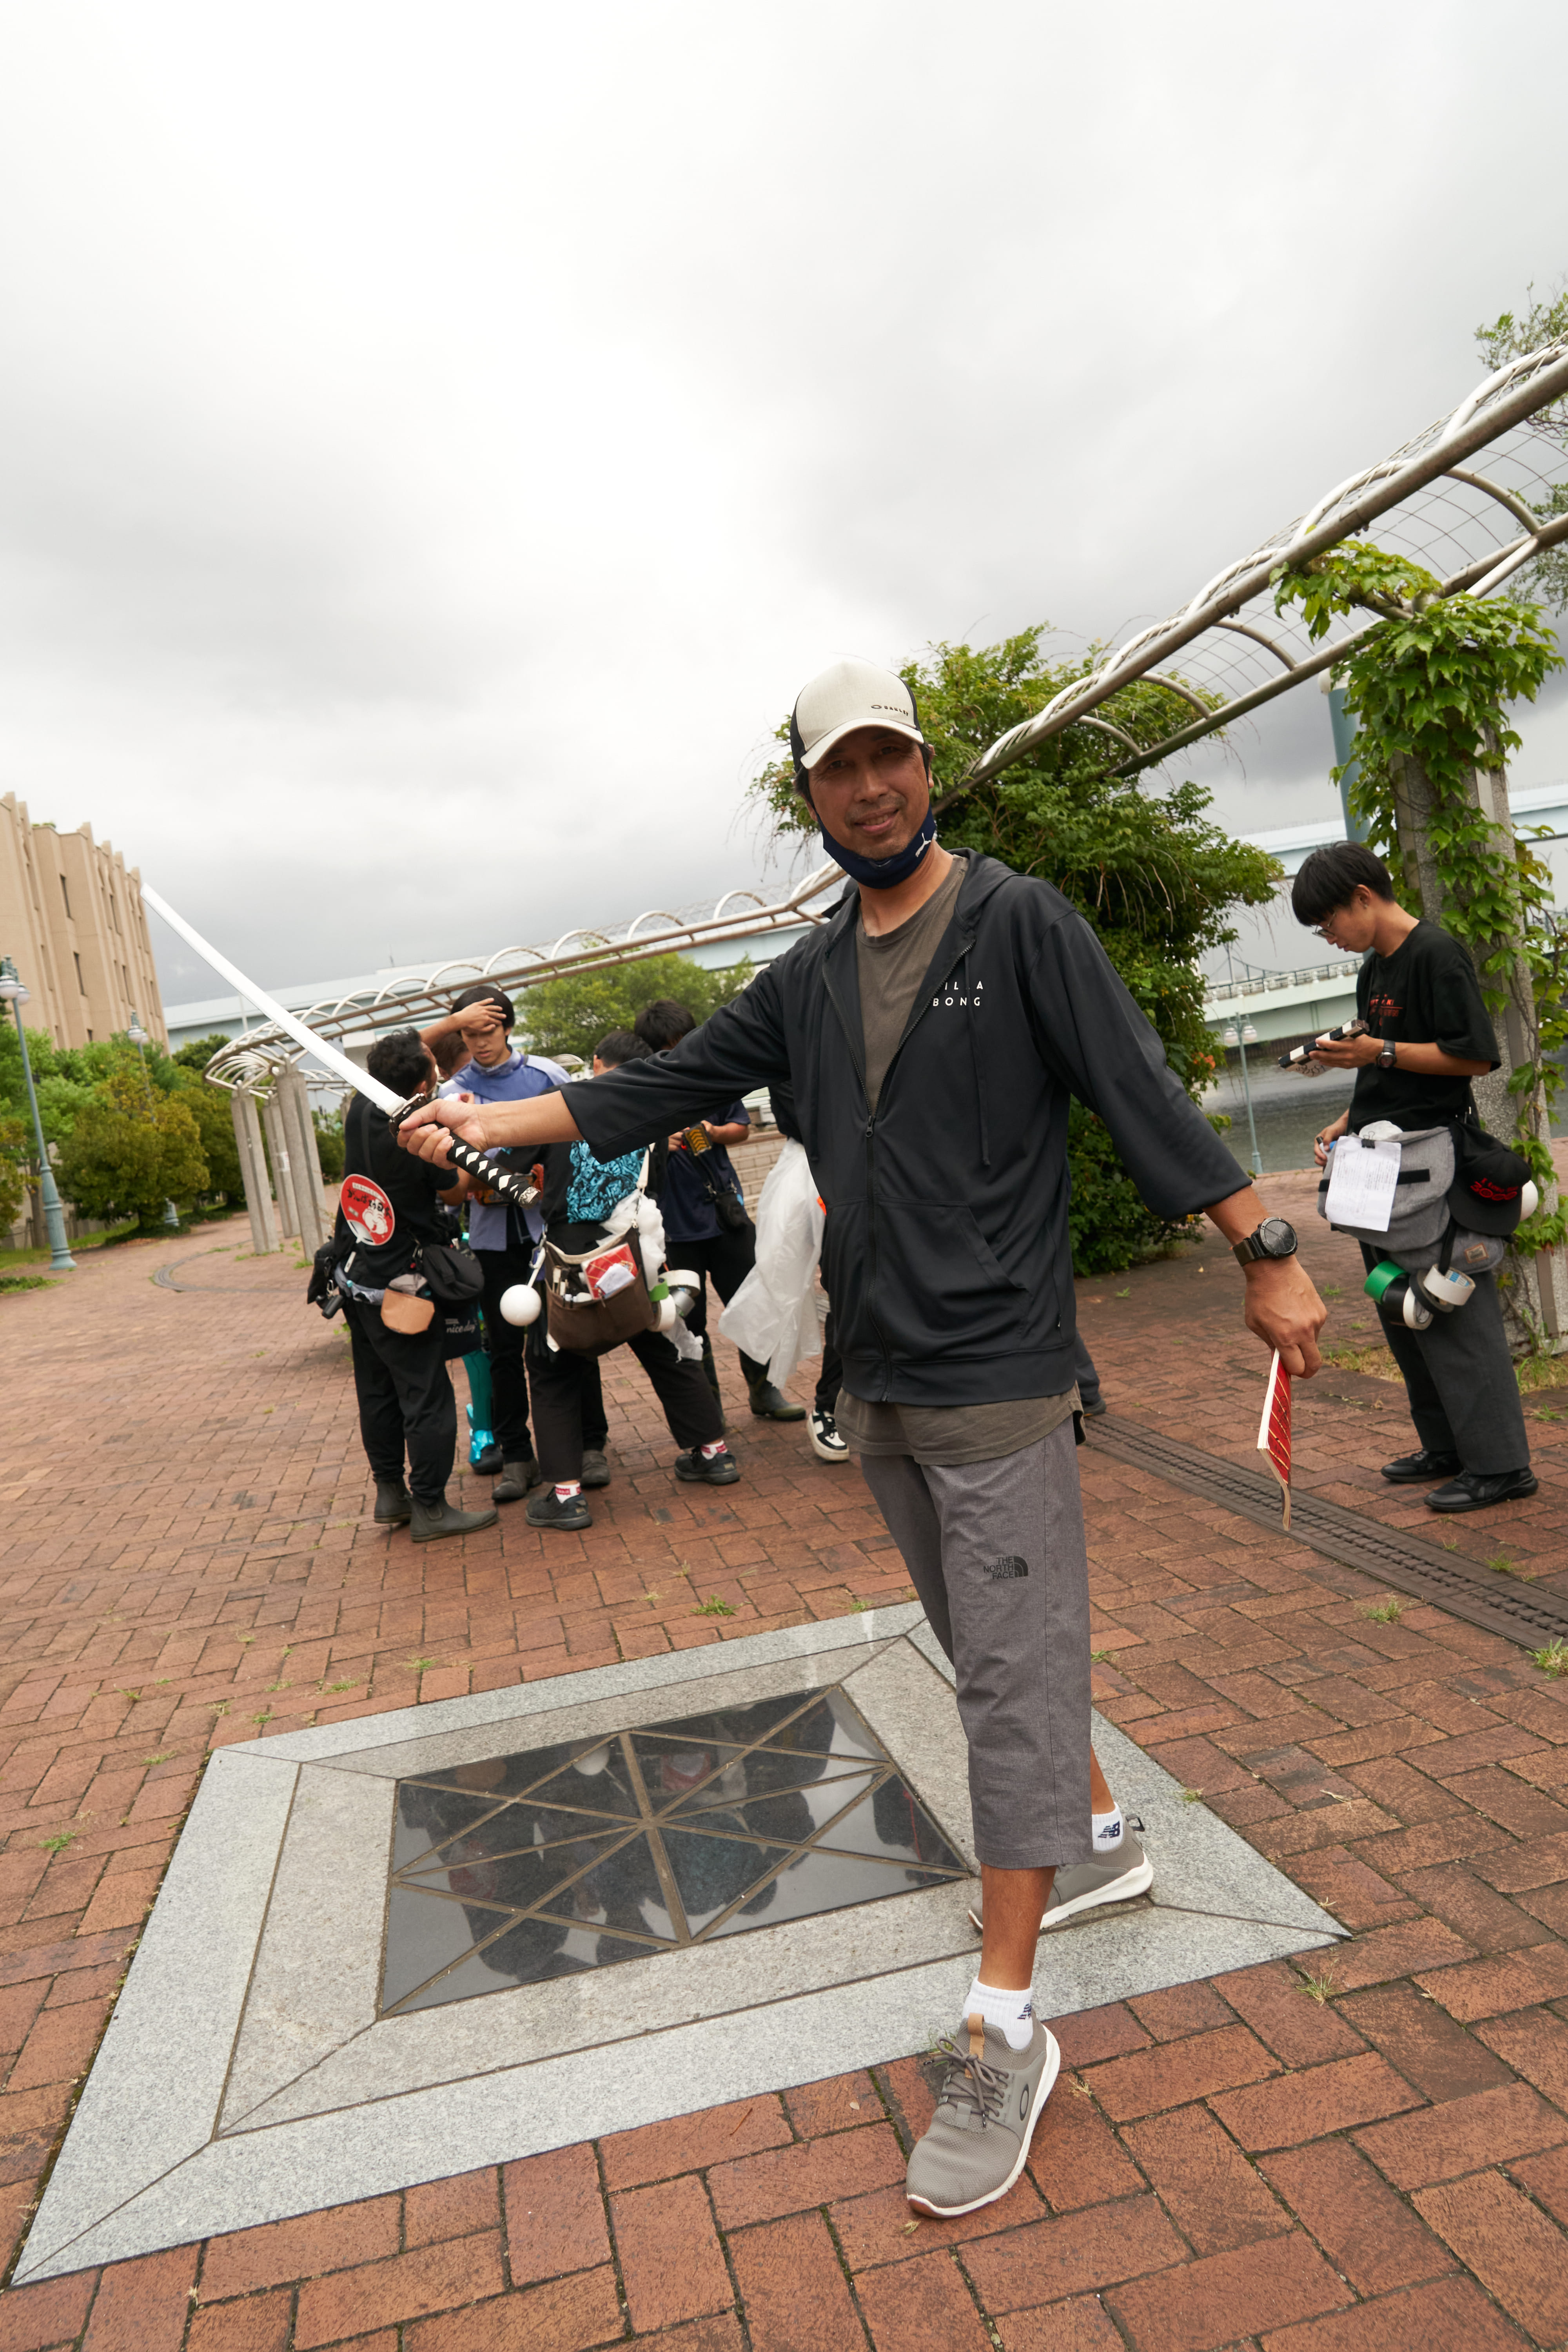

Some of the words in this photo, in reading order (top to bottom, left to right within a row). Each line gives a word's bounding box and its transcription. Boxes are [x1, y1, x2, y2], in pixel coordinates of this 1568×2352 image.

[945, 980, 983, 990] ILA
[933, 997, 980, 1006] BONG
[1470, 1181, 1517, 1201] 3000
[996, 1556, 1013, 1564] THE
[983, 1563, 1014, 1573] NORTH
[992, 1571, 1014, 1579] FACE
